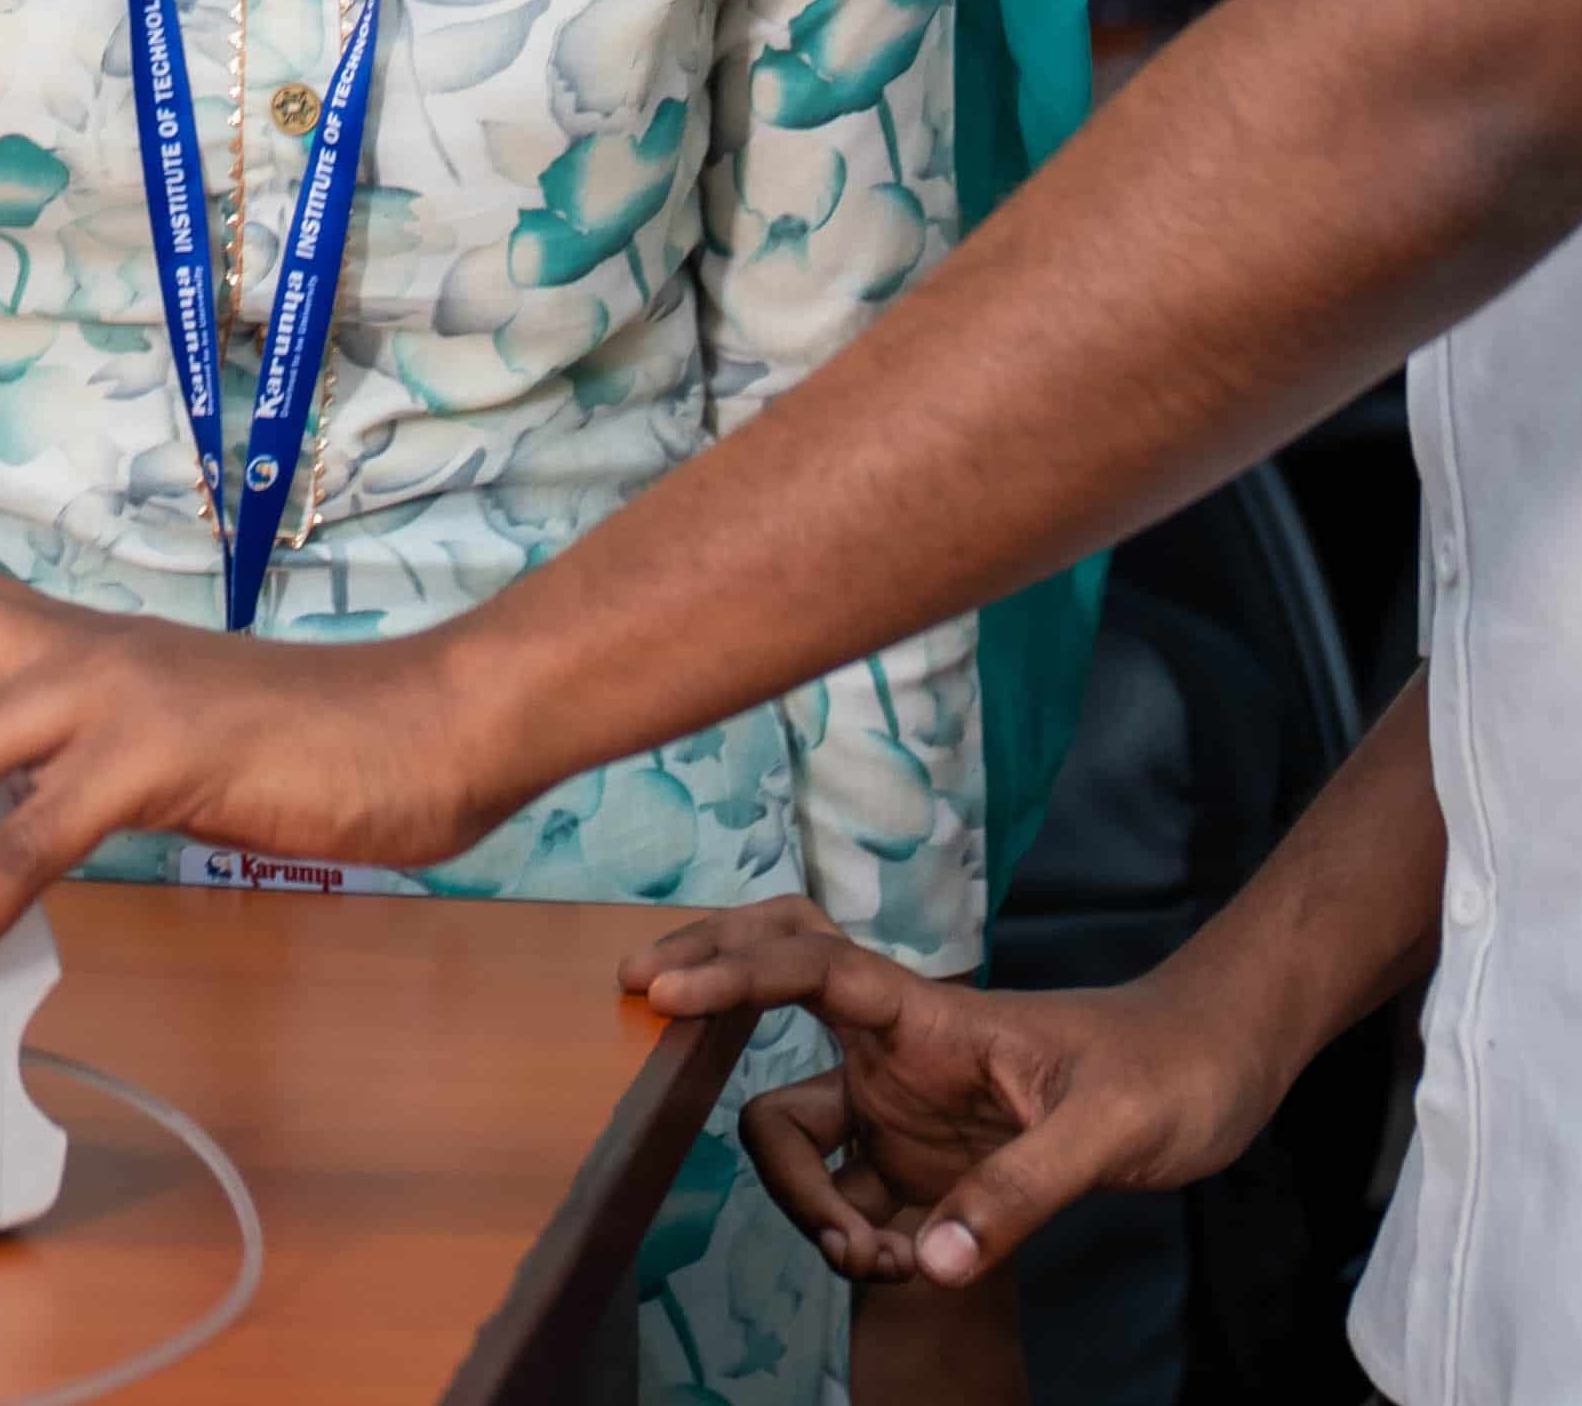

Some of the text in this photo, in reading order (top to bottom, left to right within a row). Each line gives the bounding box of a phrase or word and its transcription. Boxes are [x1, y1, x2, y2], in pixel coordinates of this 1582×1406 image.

[156, 107, 179, 139] OF
[161, 141, 194, 254] INSTITUTE
[255, 270, 305, 419] Karunya
[295, 147, 337, 260] INSTITUTE
[323, 112, 343, 145] OF
[176, 266, 208, 417] Karunya
[240, 853, 344, 893] Karunya
